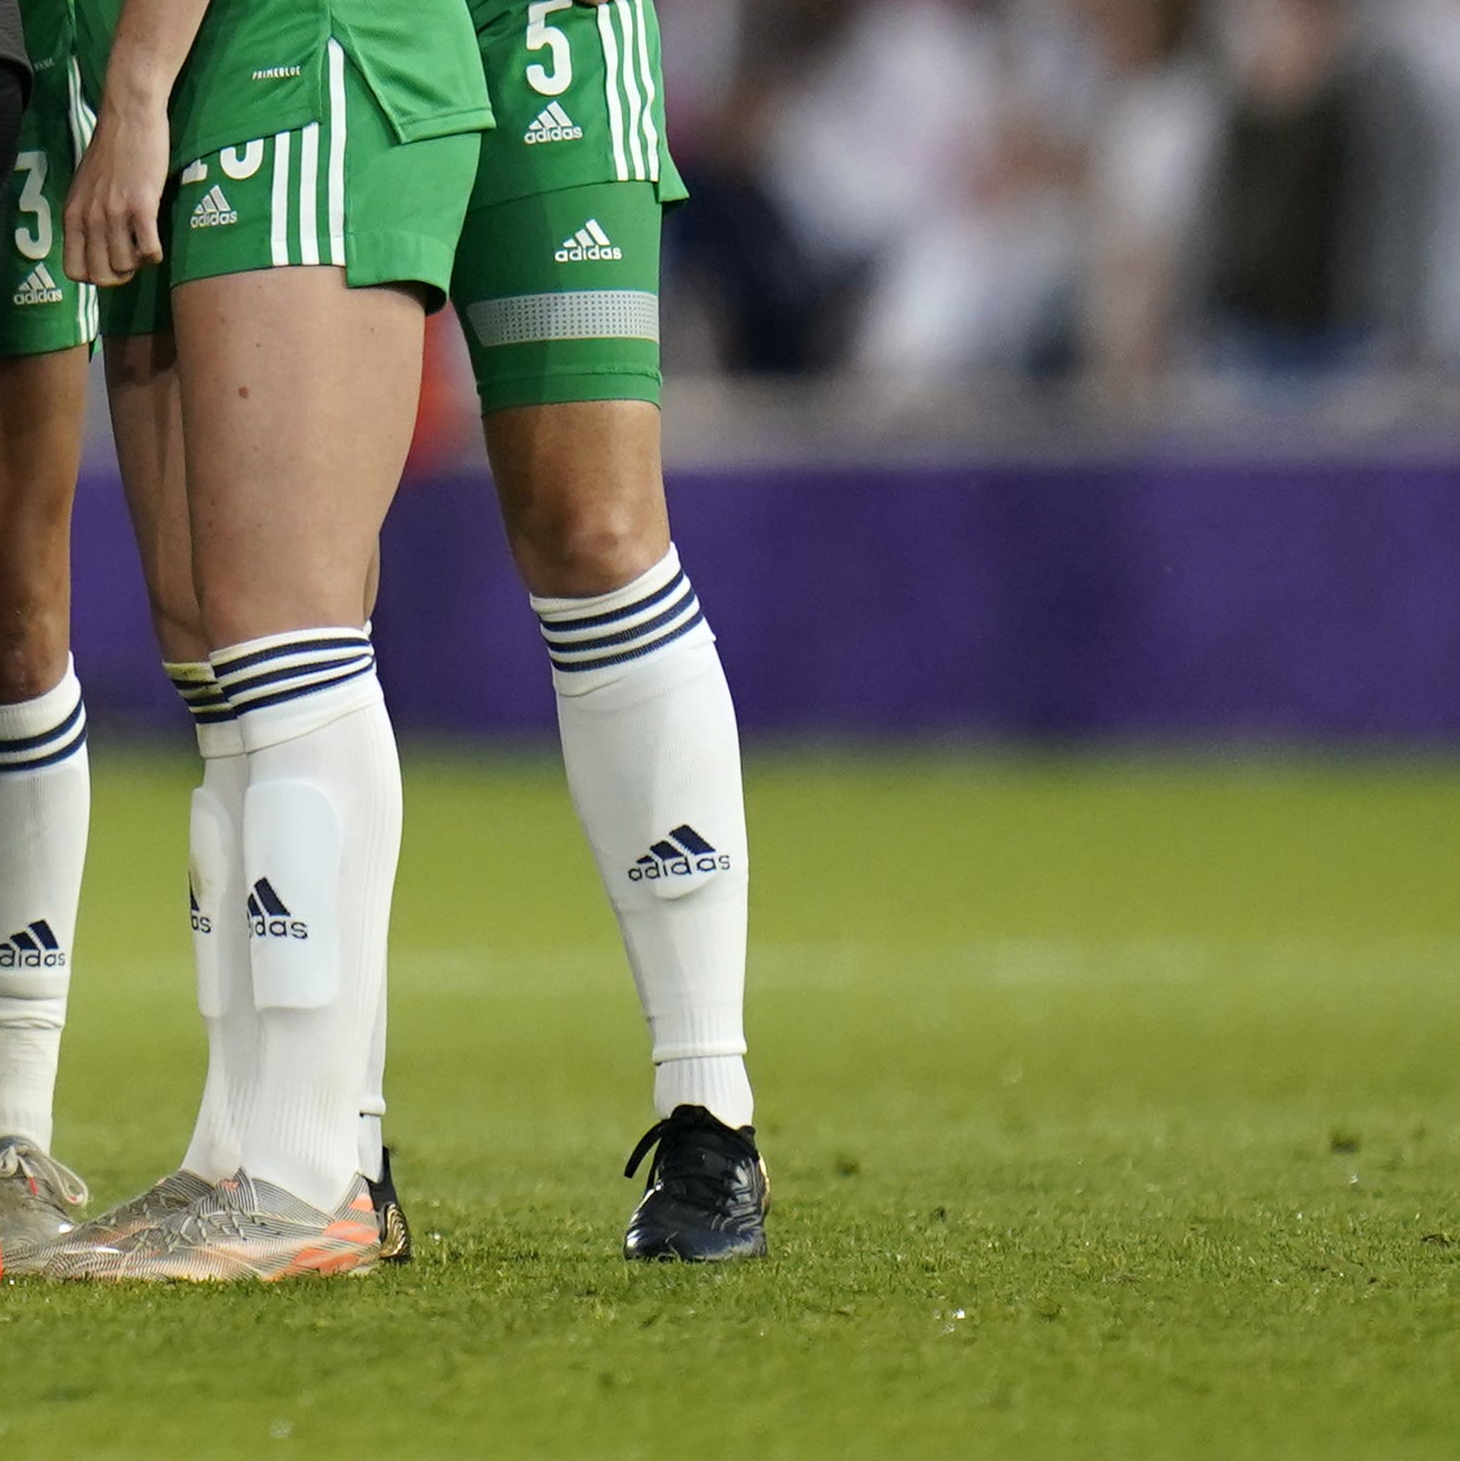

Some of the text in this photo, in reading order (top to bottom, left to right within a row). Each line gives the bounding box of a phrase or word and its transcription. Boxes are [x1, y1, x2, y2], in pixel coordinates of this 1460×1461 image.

[524, 126, 583, 144] adidas
[14, 151, 53, 259] 3
[190, 210, 238, 228] adidas
[554, 244, 622, 263] adidas
[13, 288, 63, 305] adidas
[628, 854, 731, 881] adidas
